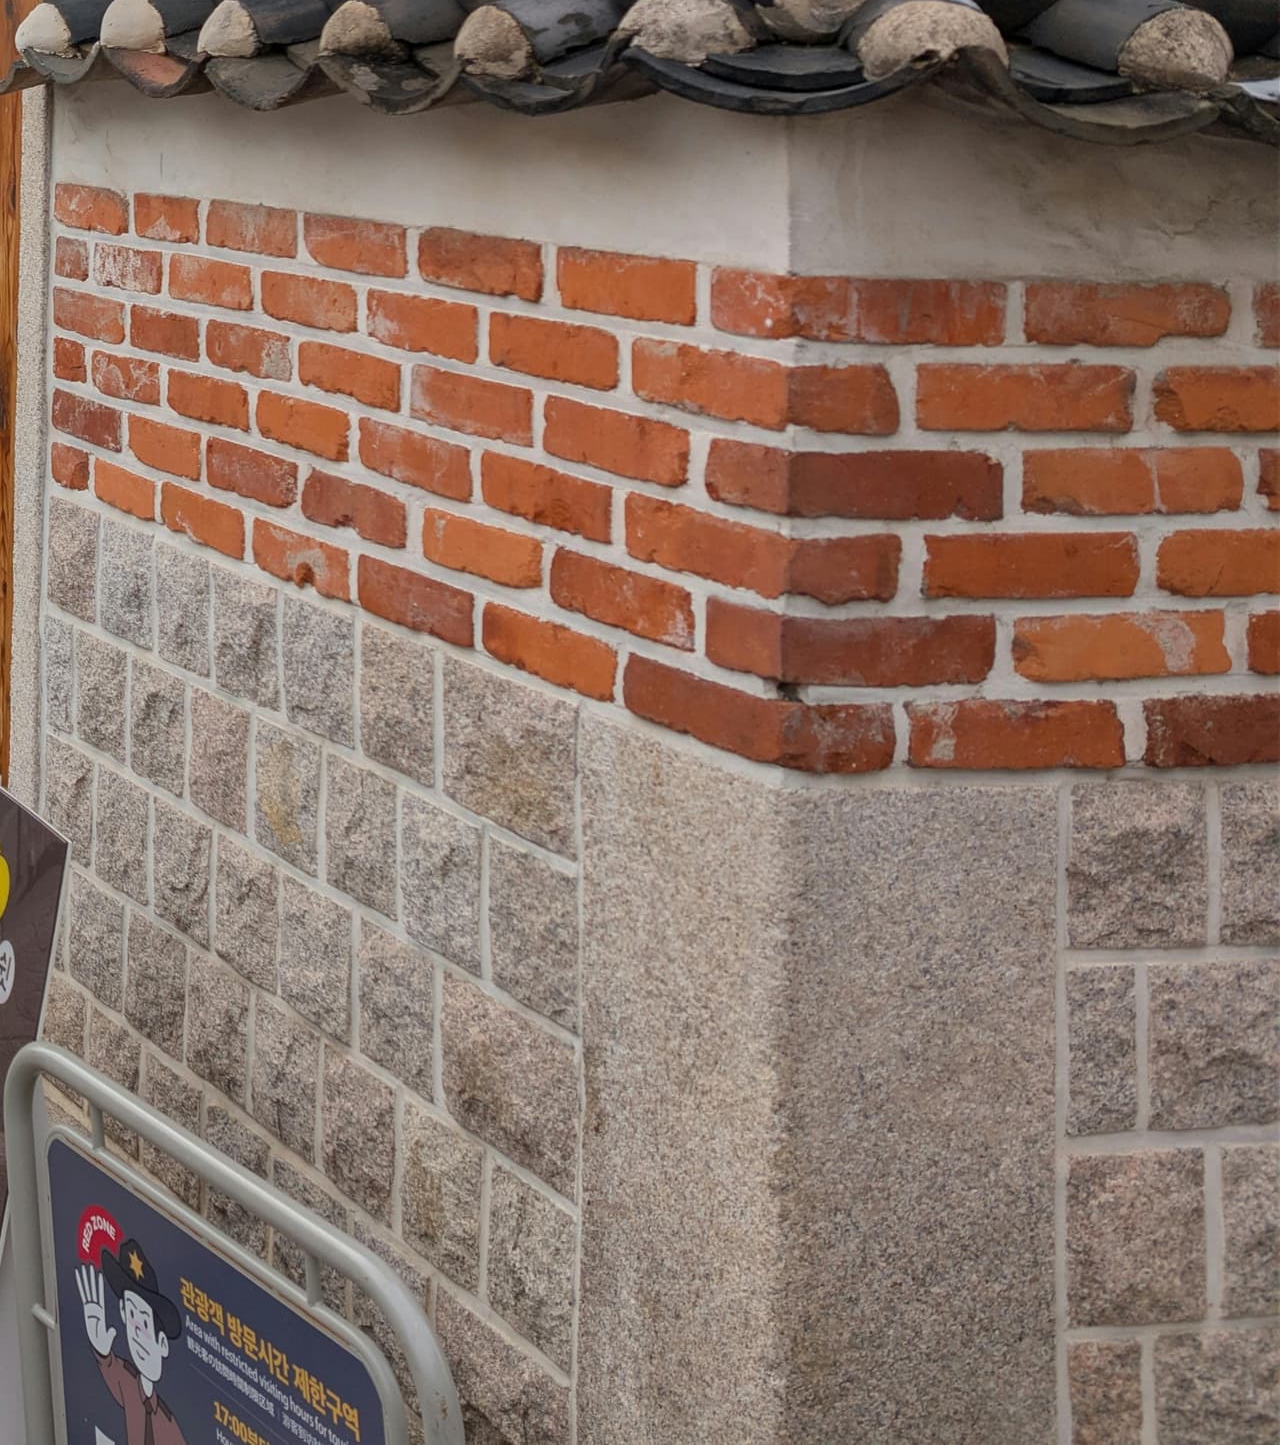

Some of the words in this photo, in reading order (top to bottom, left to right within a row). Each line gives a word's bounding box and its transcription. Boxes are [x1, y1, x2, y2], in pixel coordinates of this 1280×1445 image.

[82, 1222, 94, 1254] RED
[90, 1215, 116, 1241] ZONE
[179, 1276, 225, 1337] 관광객
[226, 1311, 290, 1386] 방문시간
[292, 1363, 361, 1443] 제한구역
[185, 1314, 204, 1339] Area
[203, 1332, 221, 1353] with
[221, 1345, 259, 1383] restricted
[259, 1375, 290, 1411] visiting
[289, 1395, 315, 1427] hours
[314, 1416, 327, 1438] for
